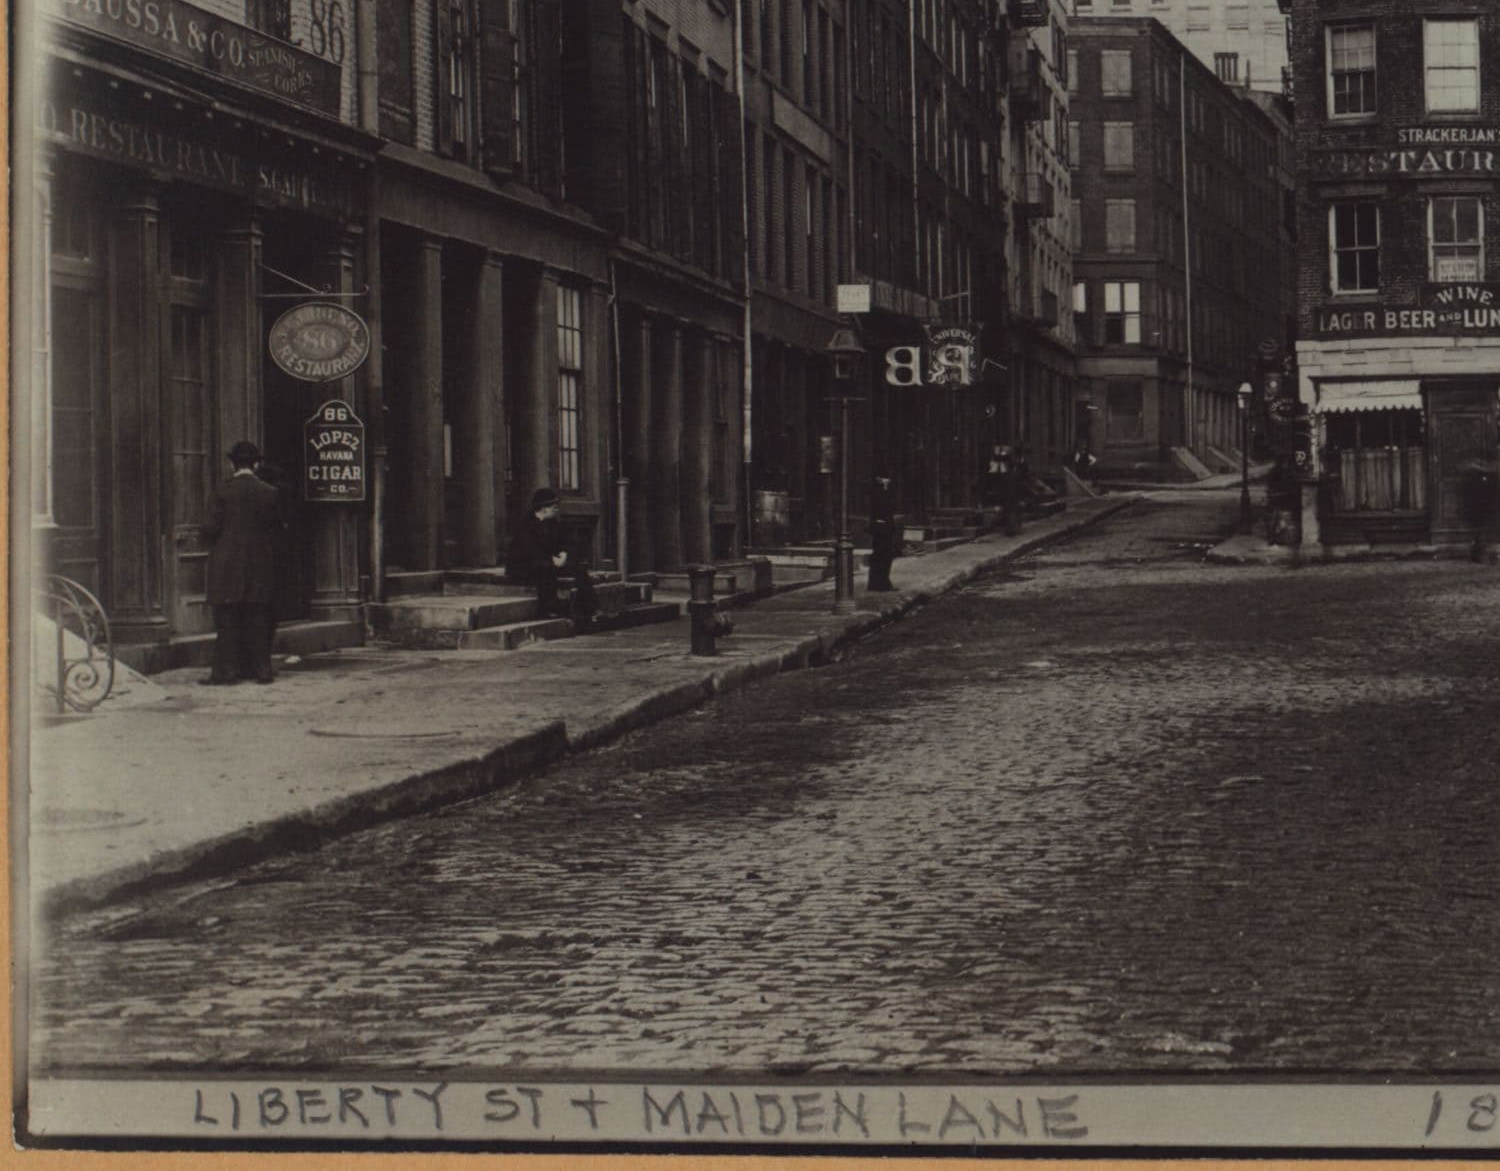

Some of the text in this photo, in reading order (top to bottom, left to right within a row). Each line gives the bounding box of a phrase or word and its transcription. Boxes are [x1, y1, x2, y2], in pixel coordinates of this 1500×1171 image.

[186, 19, 209, 53] &
[210, 31, 246, 69] CO.
[1436, 285, 1494, 306] WINE
[1319, 311, 1375, 333] LAGER
[1384, 309, 1437, 329] BEER
[1438, 312, 1461, 324] AND
[303, 331, 337, 349] 86
[278, 339, 362, 376] RESTAURANT
[324, 408, 347, 421] 86
[309, 430, 360, 451] LOPEZ
[319, 450, 354, 461] HAVANA
[308, 465, 362, 481] CIGAR
